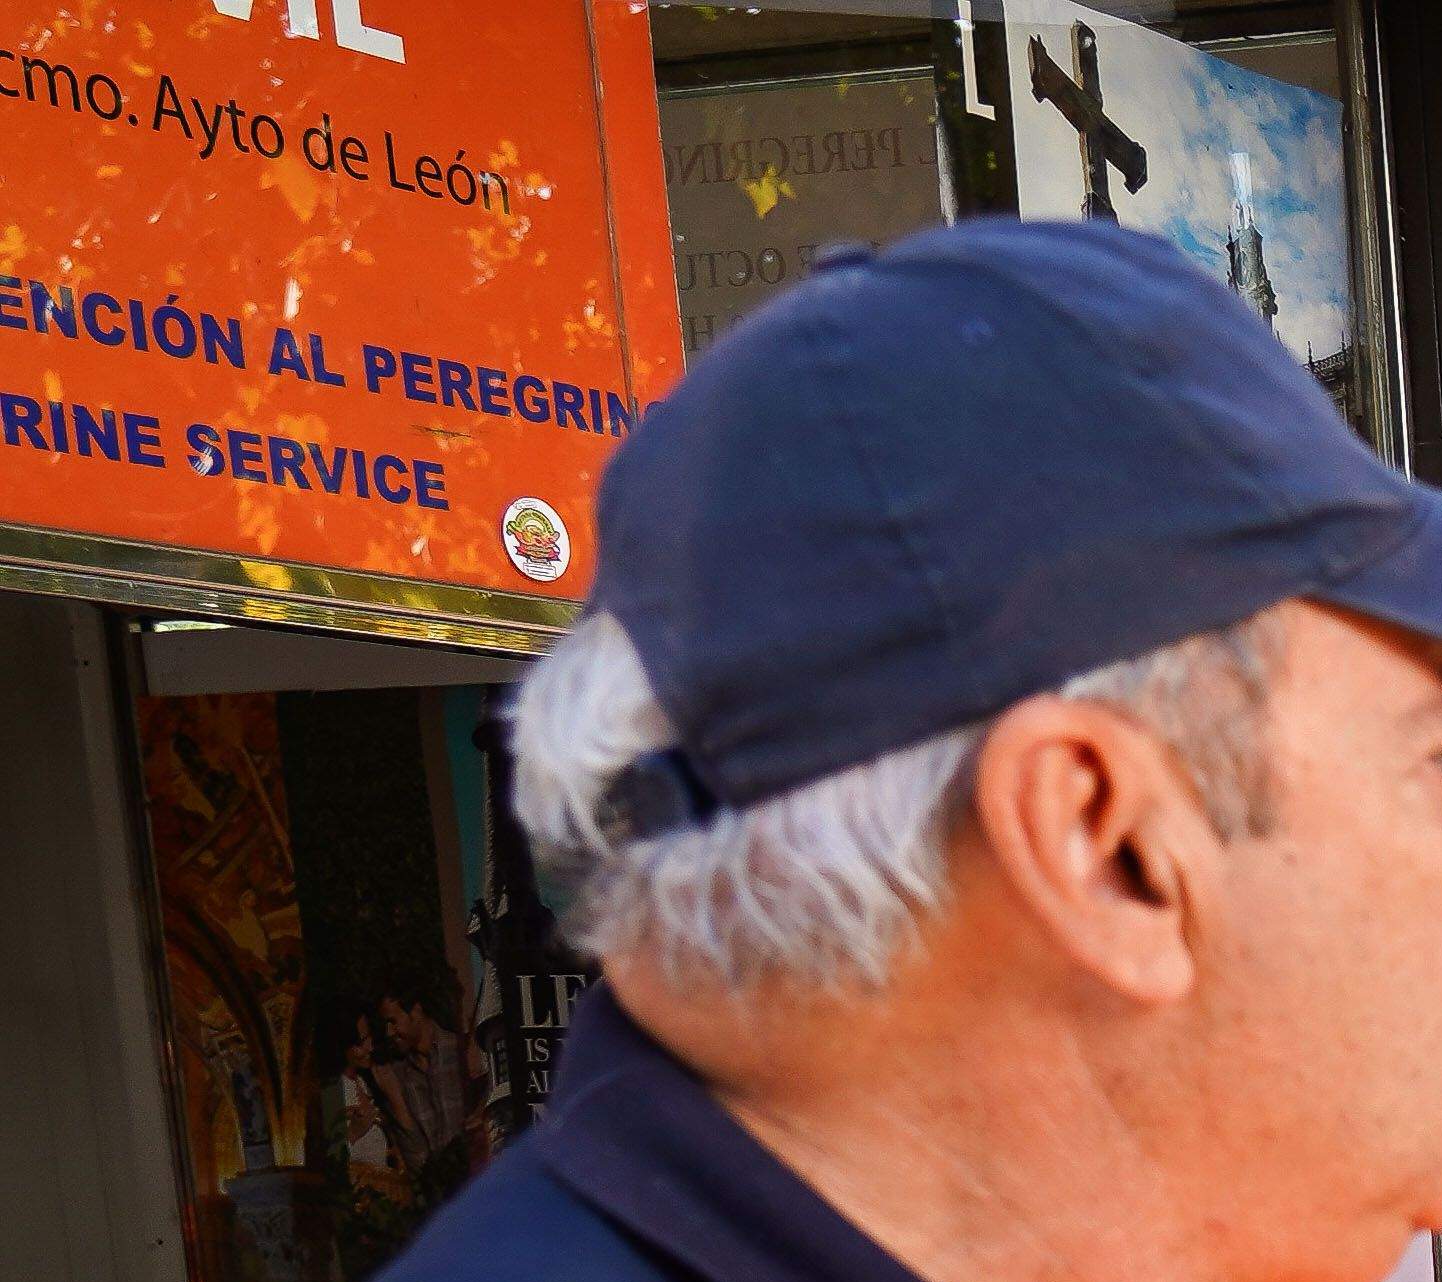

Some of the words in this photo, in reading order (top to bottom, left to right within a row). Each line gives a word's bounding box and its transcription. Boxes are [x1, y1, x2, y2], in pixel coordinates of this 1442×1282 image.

[152, 74, 286, 160] Ayto
[303, 113, 369, 182] de
[384, 131, 512, 214] León
[270, 328, 346, 388] AL
[363, 345, 666, 439] PEREGRIN
[0, 392, 166, 468] RINE
[186, 423, 450, 511] SERVICE
